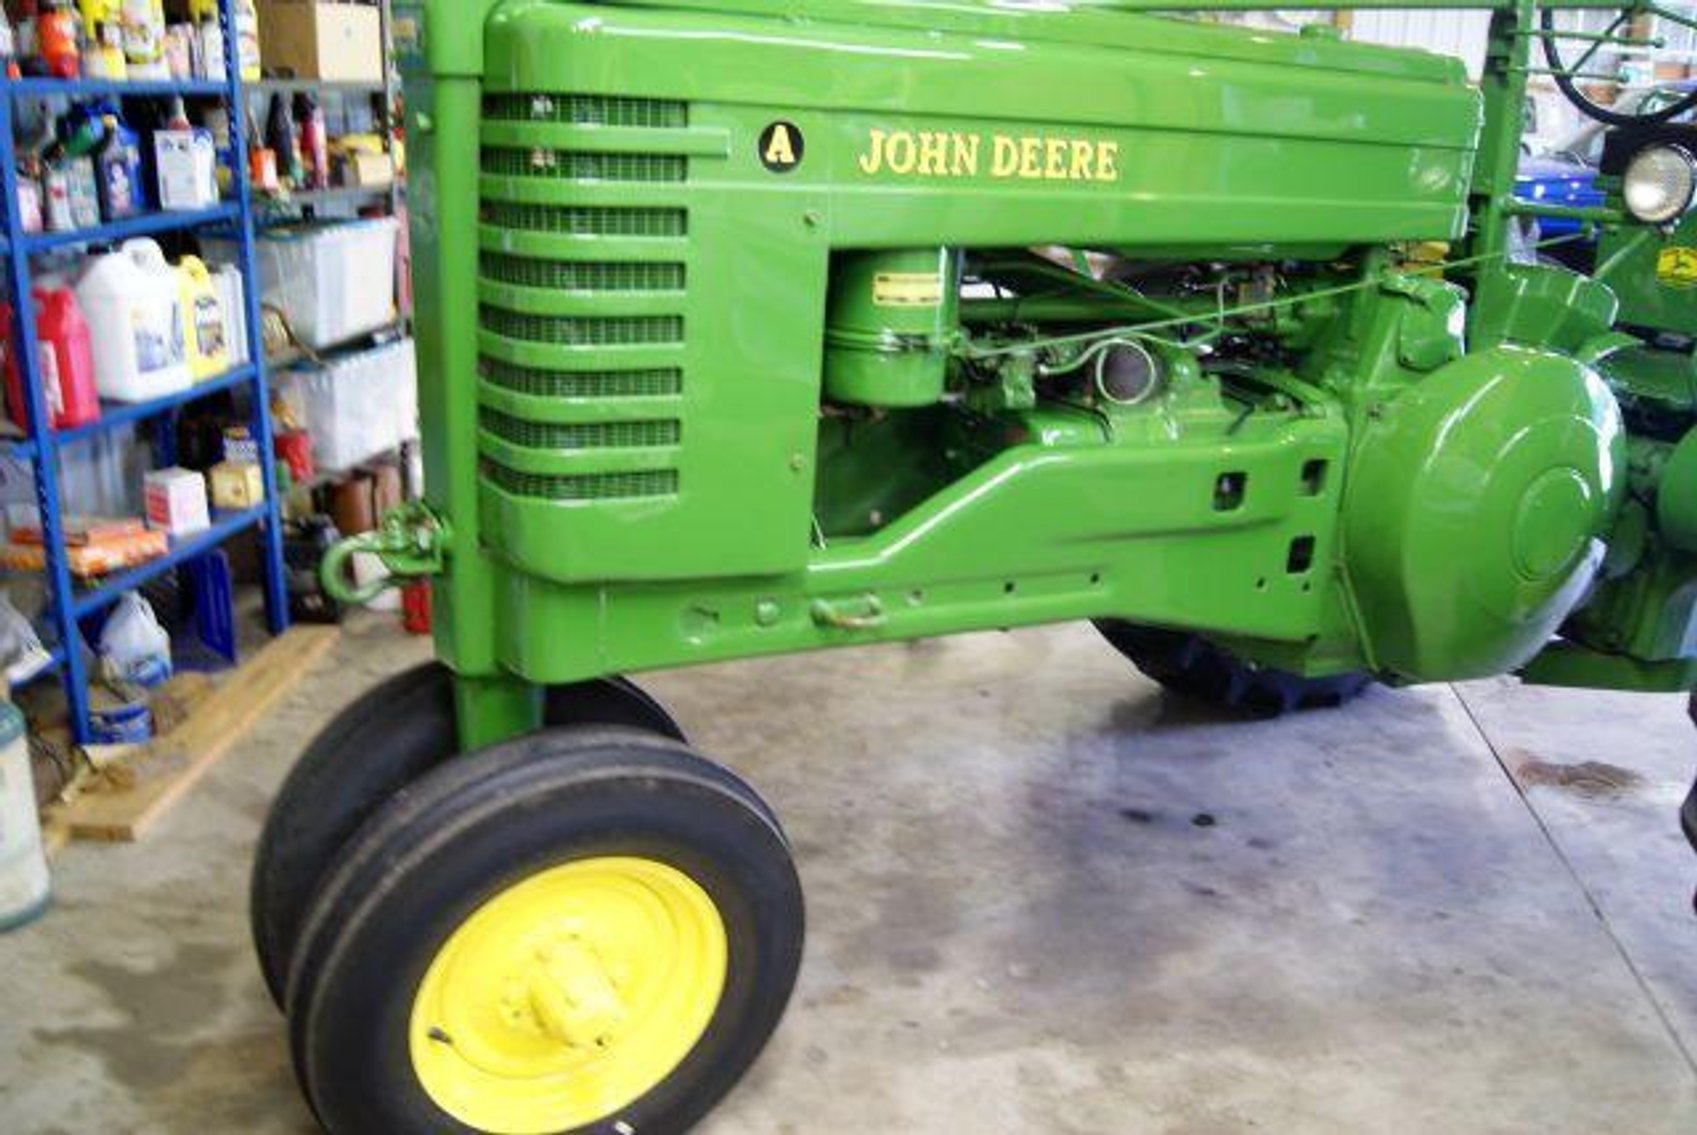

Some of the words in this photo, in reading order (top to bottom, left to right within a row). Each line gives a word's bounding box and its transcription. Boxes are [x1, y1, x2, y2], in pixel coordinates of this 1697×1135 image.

[764, 124, 796, 164] A
[859, 128, 980, 176] JOHN
[991, 134, 1118, 181] DEERE
